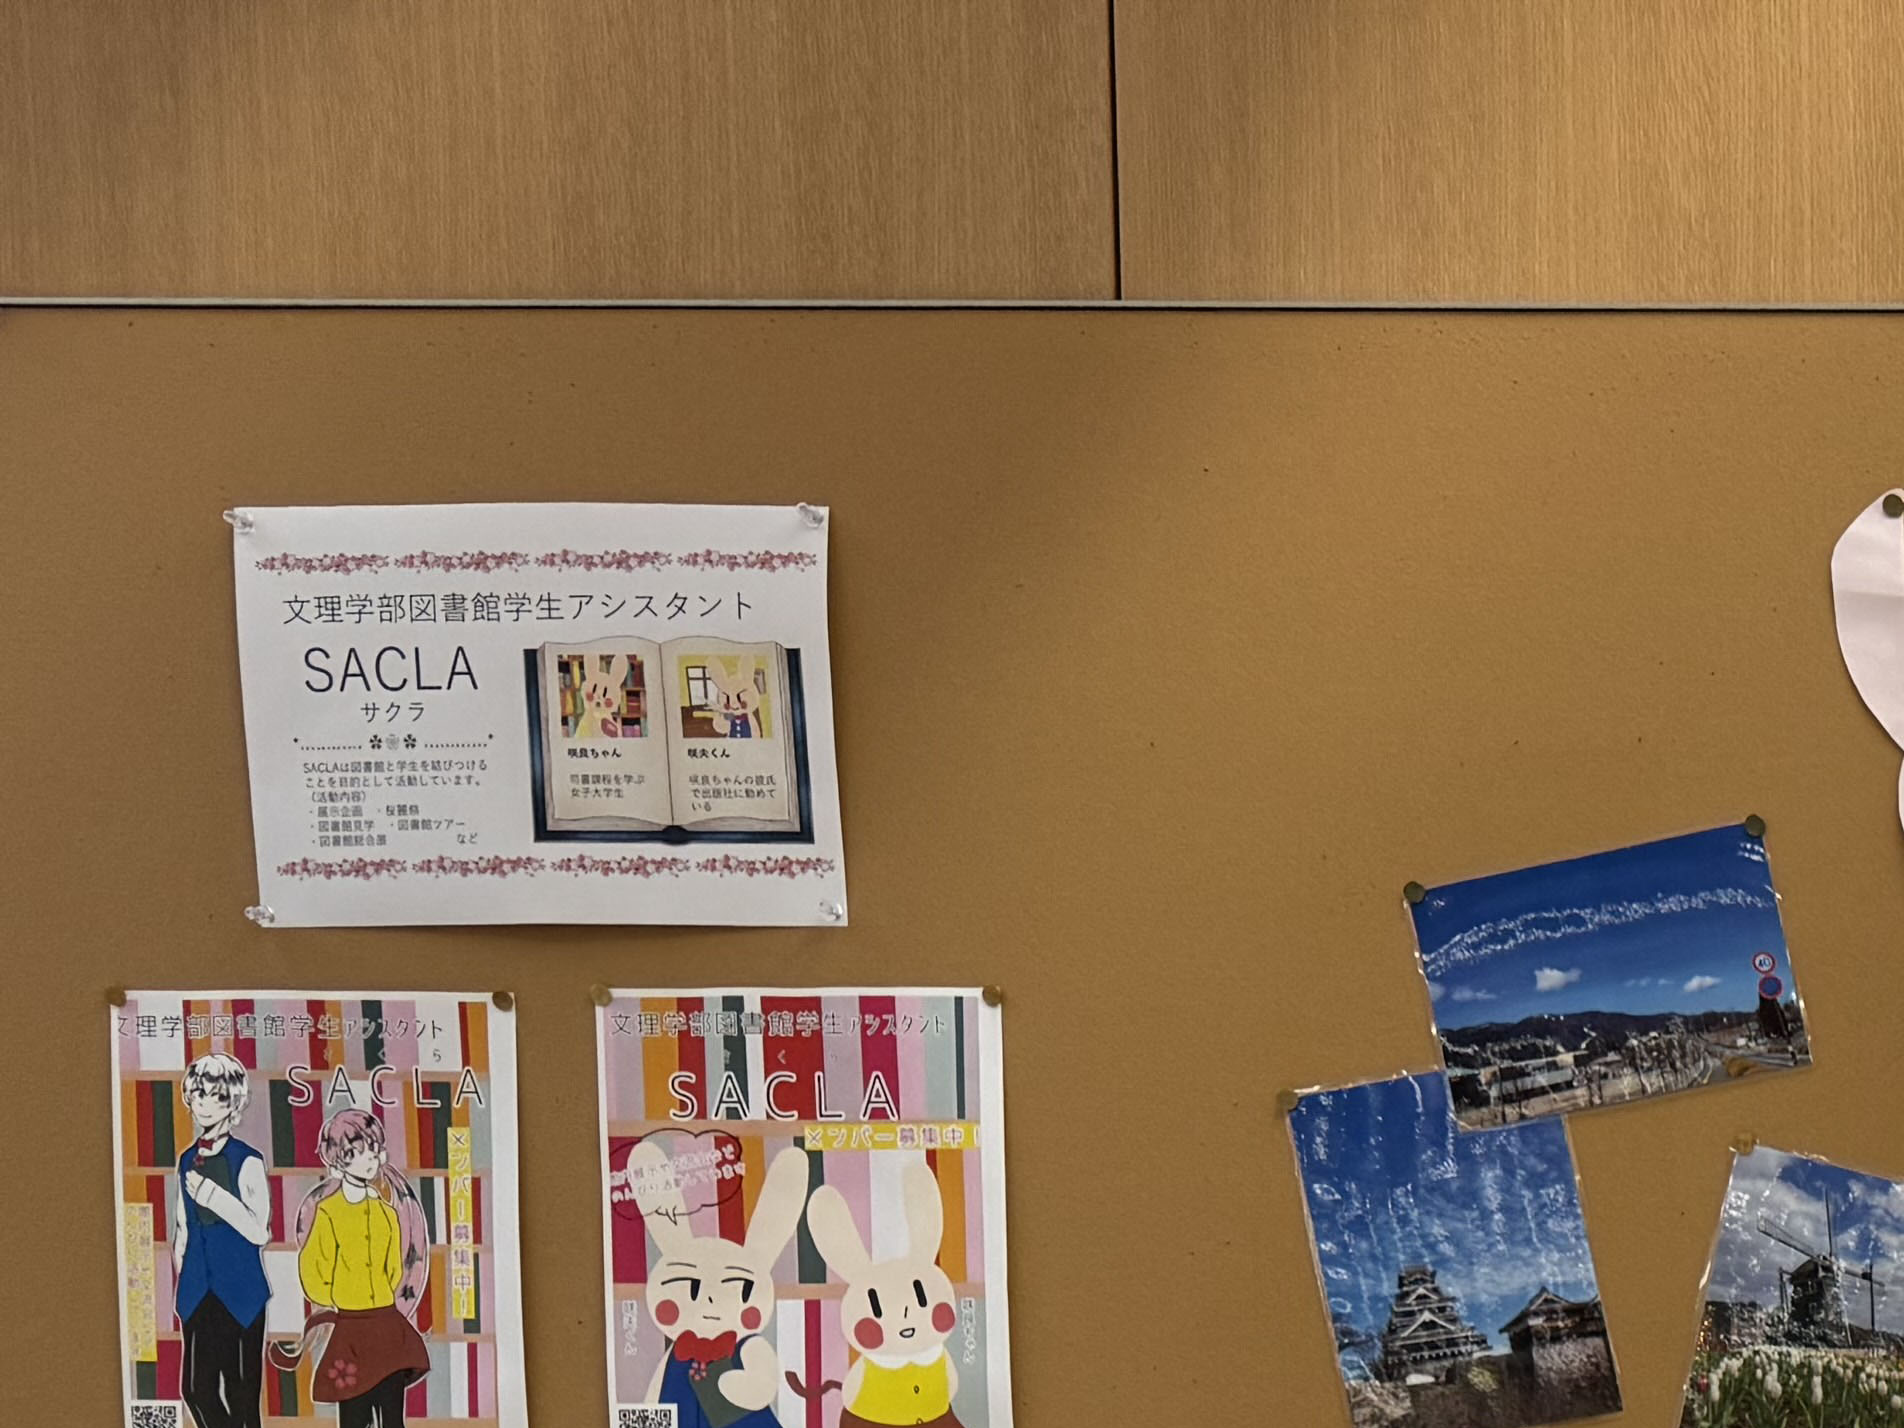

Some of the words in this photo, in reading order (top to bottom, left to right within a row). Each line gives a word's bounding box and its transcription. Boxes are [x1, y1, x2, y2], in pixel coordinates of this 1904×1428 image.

[283, 592, 754, 625] 文理学部図書館学生アシスタント
[304, 645, 478, 693] SACLA
[360, 701, 425, 722] サクラ
[611, 1012, 946, 1036] 文理学部図書館学生アシスタント
[288, 1065, 483, 1106] SACLA
[669, 1072, 898, 1121] SACLA
